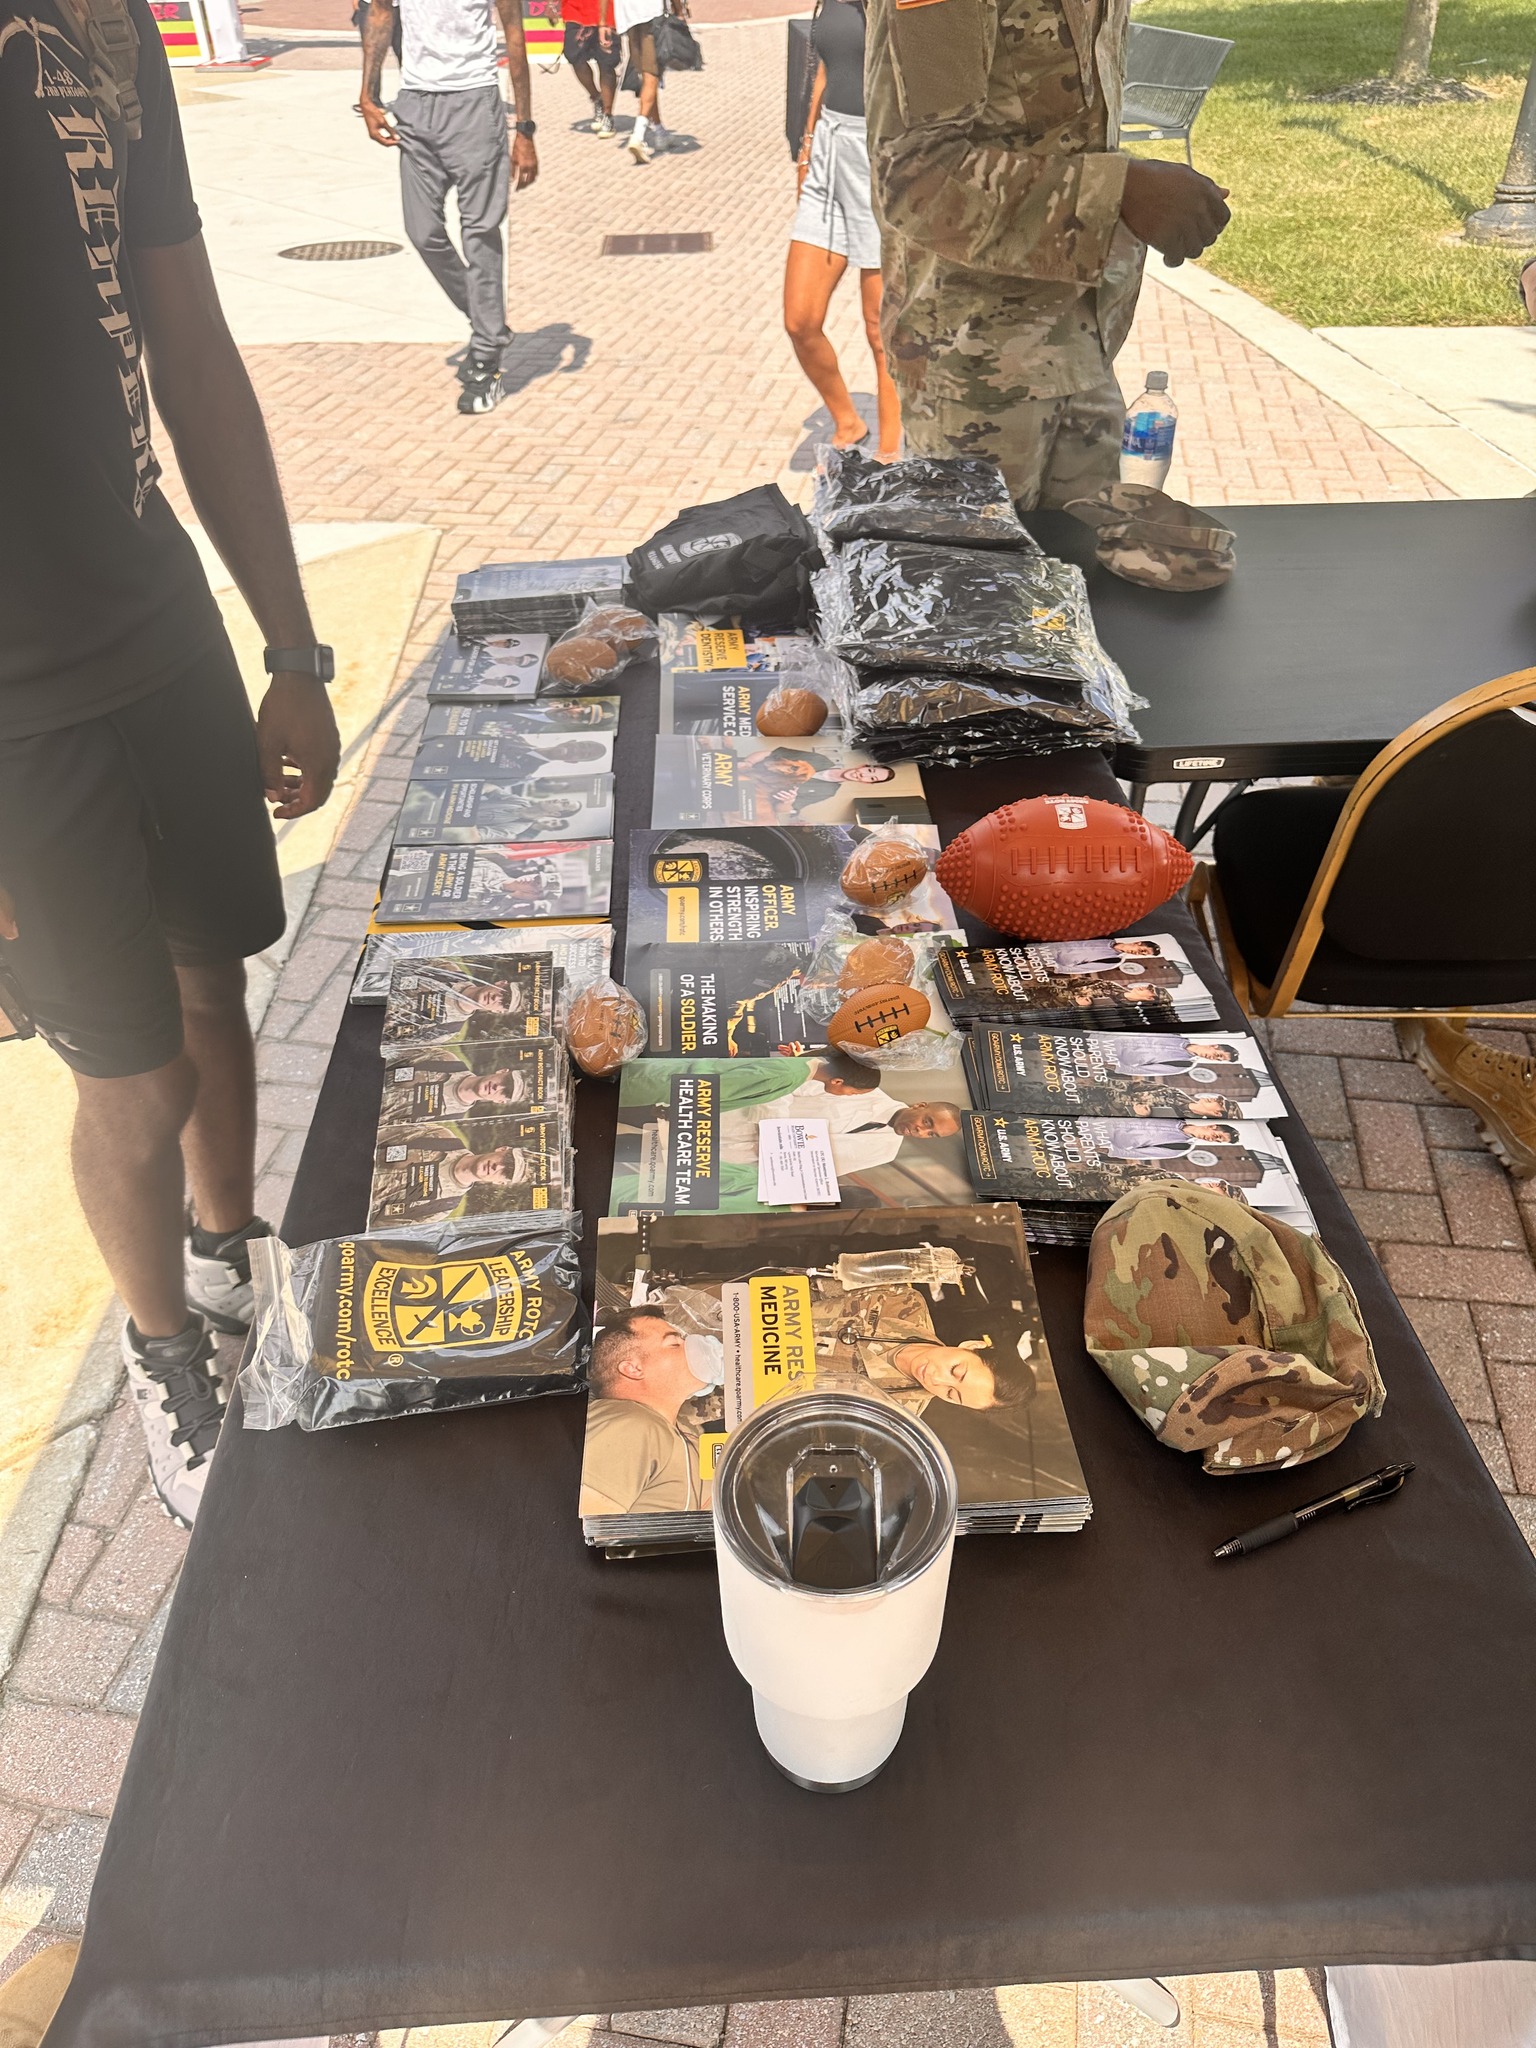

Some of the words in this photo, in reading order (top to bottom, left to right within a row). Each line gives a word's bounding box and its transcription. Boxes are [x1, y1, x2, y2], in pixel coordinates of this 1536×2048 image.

[44, 69, 73, 86] 1-48
[701, 634, 714, 667] DENTISTRY
[714, 633, 727, 660] RESERVE
[727, 633, 739, 650] ARMY
[722, 686, 736, 728] SERVICE
[738, 686, 751, 715] ARMY
[702, 752, 712, 788] VETERINARY
[714, 752, 733, 787] ARMY
[702, 790, 712, 809] CORPS
[437, 853, 448, 870] ARMY
[447, 860, 458, 871] THE
[457, 853, 469, 870] BEING
[431, 871, 445, 896] RESERVE
[441, 889, 452, 897] OR
[444, 872, 455, 889] ARMY
[452, 876, 465, 899] SOLDIER
[709, 886, 723, 898] IN
[726, 886, 743, 941] STRENGTH
[744, 885, 761, 938] INSPIRING
[762, 884, 779, 932] OFFICER.
[780, 884, 796, 915] ARMY
[568, 943, 578, 969] SUCCESS
[578, 943, 587, 958] PATH
[960, 959, 969, 969] U.S.
[1009, 947, 1033, 981] SHOULD
[1024, 947, 1049, 983] PARENTS
[1039, 946, 1058, 969] WHAT
[680, 974, 695, 988] OF
[701, 973, 715, 995] THE
[963, 969, 976, 985] ARMY
[980, 949, 1000, 972] ARMY
[990, 973, 1009, 995] ROTC
[995, 948, 1015, 974] KNOW
[1006, 974, 1028, 1001] ABOUT
[680, 989, 695, 998] A
[681, 998, 696, 1054] SOLDIER.
[701, 996, 717, 1045] MAKING
[1012, 1044, 1022, 1057] U.S.
[1038, 1034, 1052, 1064] ARMY
[1053, 1035, 1071, 1068] KNOW
[1070, 1037, 1090, 1078] SHOULD
[1086, 1038, 1108, 1083] PARENTS
[1102, 1039, 1121, 1067] WHAT
[1015, 1058, 1026, 1076] ARMY
[1043, 1065, 1060, 1093] ROTC
[697, 1079, 712, 1117] ARMY
[1060, 1069, 1080, 1103] ABOUT
[678, 1079, 694, 1129] HEALTH
[676, 1132, 693, 1167] CARE
[695, 1120, 711, 1178] RESERVE
[795, 1125, 805, 1149] BOWIE
[996, 1129, 1007, 1141] U.S.
[1023, 1118, 1041, 1150] ARMY
[1041, 1119, 1061, 1153] KNOW
[1058, 1120, 1081, 1163] SHOULD
[1075, 1120, 1101, 1167] PARENTS
[1093, 1121, 1112, 1151] WHAT
[648, 1129, 659, 1197] healthcare.goarmy.com
[999, 1142, 1012, 1162] ARMY
[1031, 1150, 1051, 1178] ROTC
[674, 1169, 692, 1205] TEAM
[1049, 1153, 1073, 1188] ABOUT
[510, 1249, 542, 1292] ARMY
[335, 1241, 357, 1381] goarmy.com/rotc
[370, 1267, 397, 1346] EXCELLENCE
[488, 1262, 515, 1336] LEADERSHIP
[782, 1285, 803, 1340] ARMY
[519, 1296, 543, 1341] ROTC
[732, 1292, 742, 1348] 1-800-USA-ARMY
[760, 1286, 781, 1375] MEDICINE
[866, 1309, 880, 1326] KING
